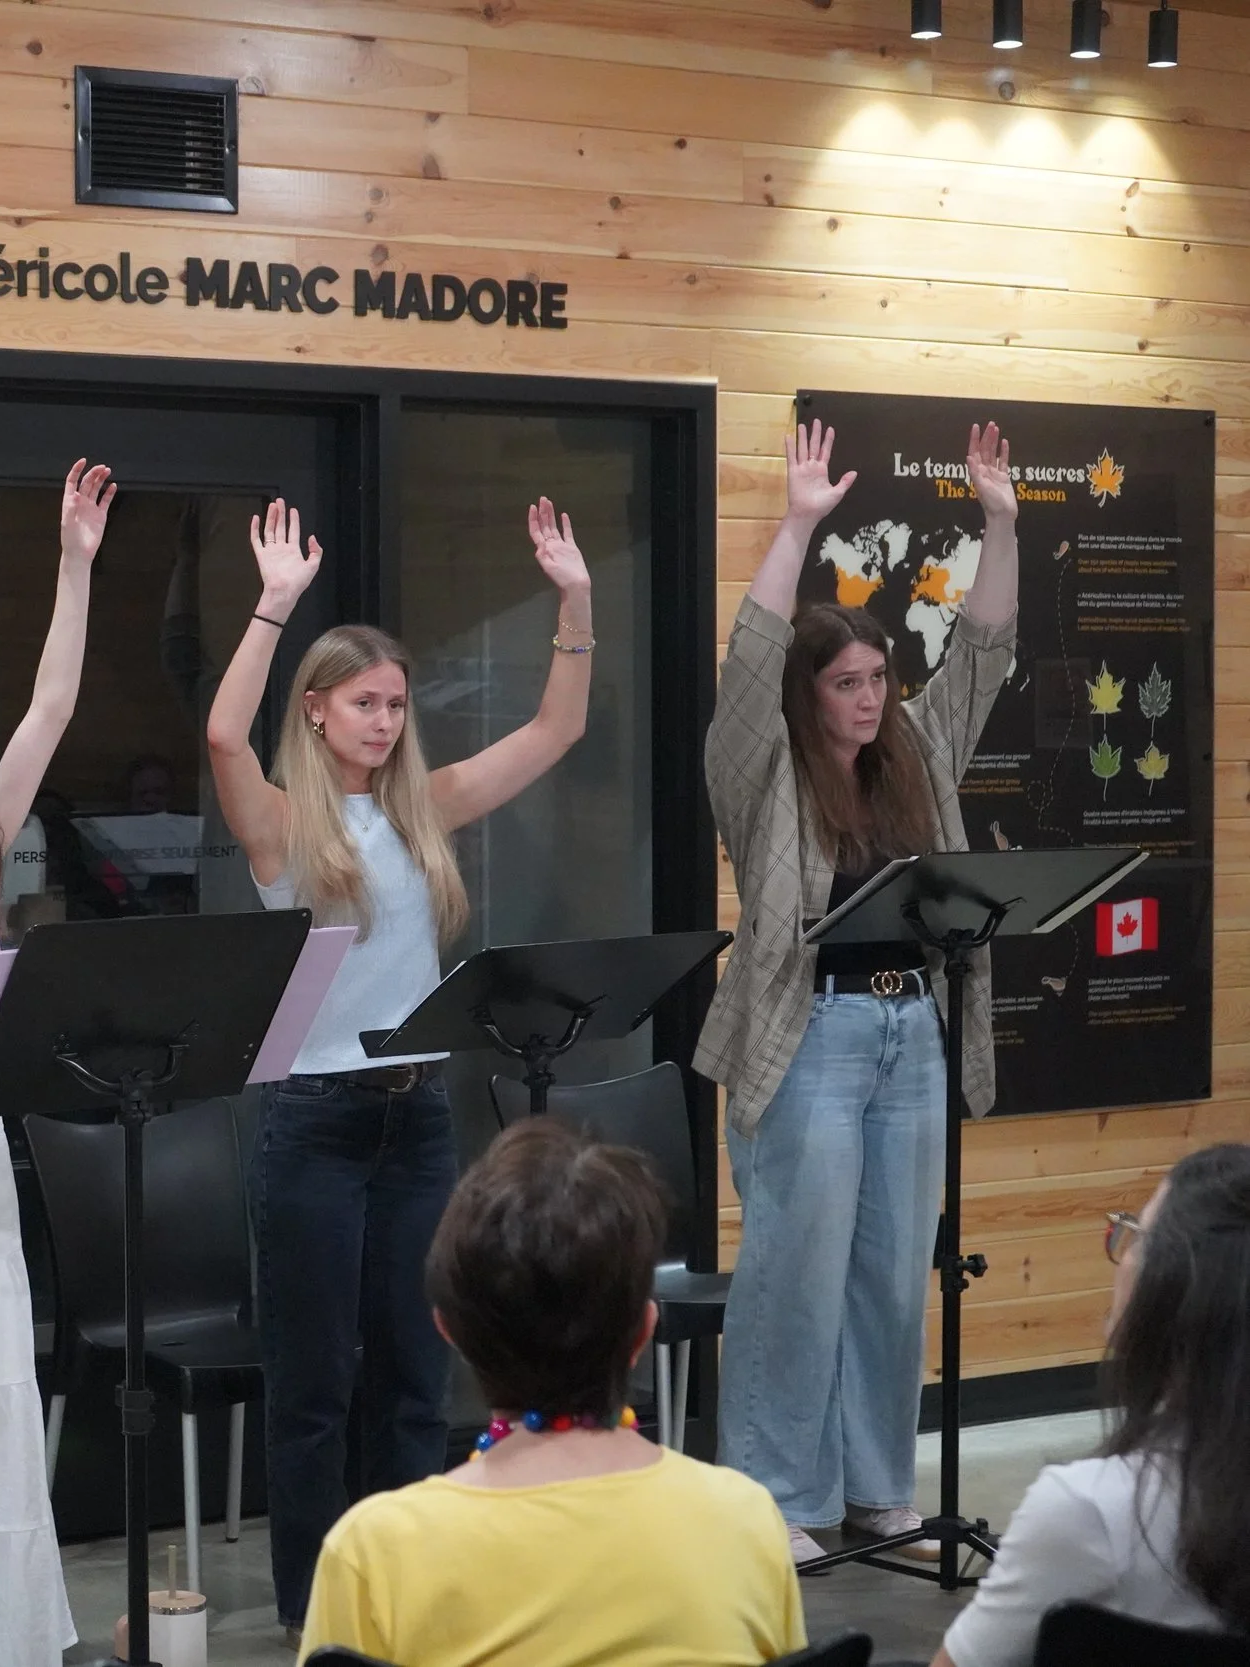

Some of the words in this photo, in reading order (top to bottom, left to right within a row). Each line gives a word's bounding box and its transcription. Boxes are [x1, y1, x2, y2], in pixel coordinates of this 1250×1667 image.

[186, 257, 340, 315] MARC
[354, 269, 568, 329] MADORE
[894, 453, 920, 477] Le
[924, 457, 971, 486] tem
[1025, 465, 1086, 483] sucres
[936, 480, 965, 498] The
[1016, 483, 1067, 502] Season
